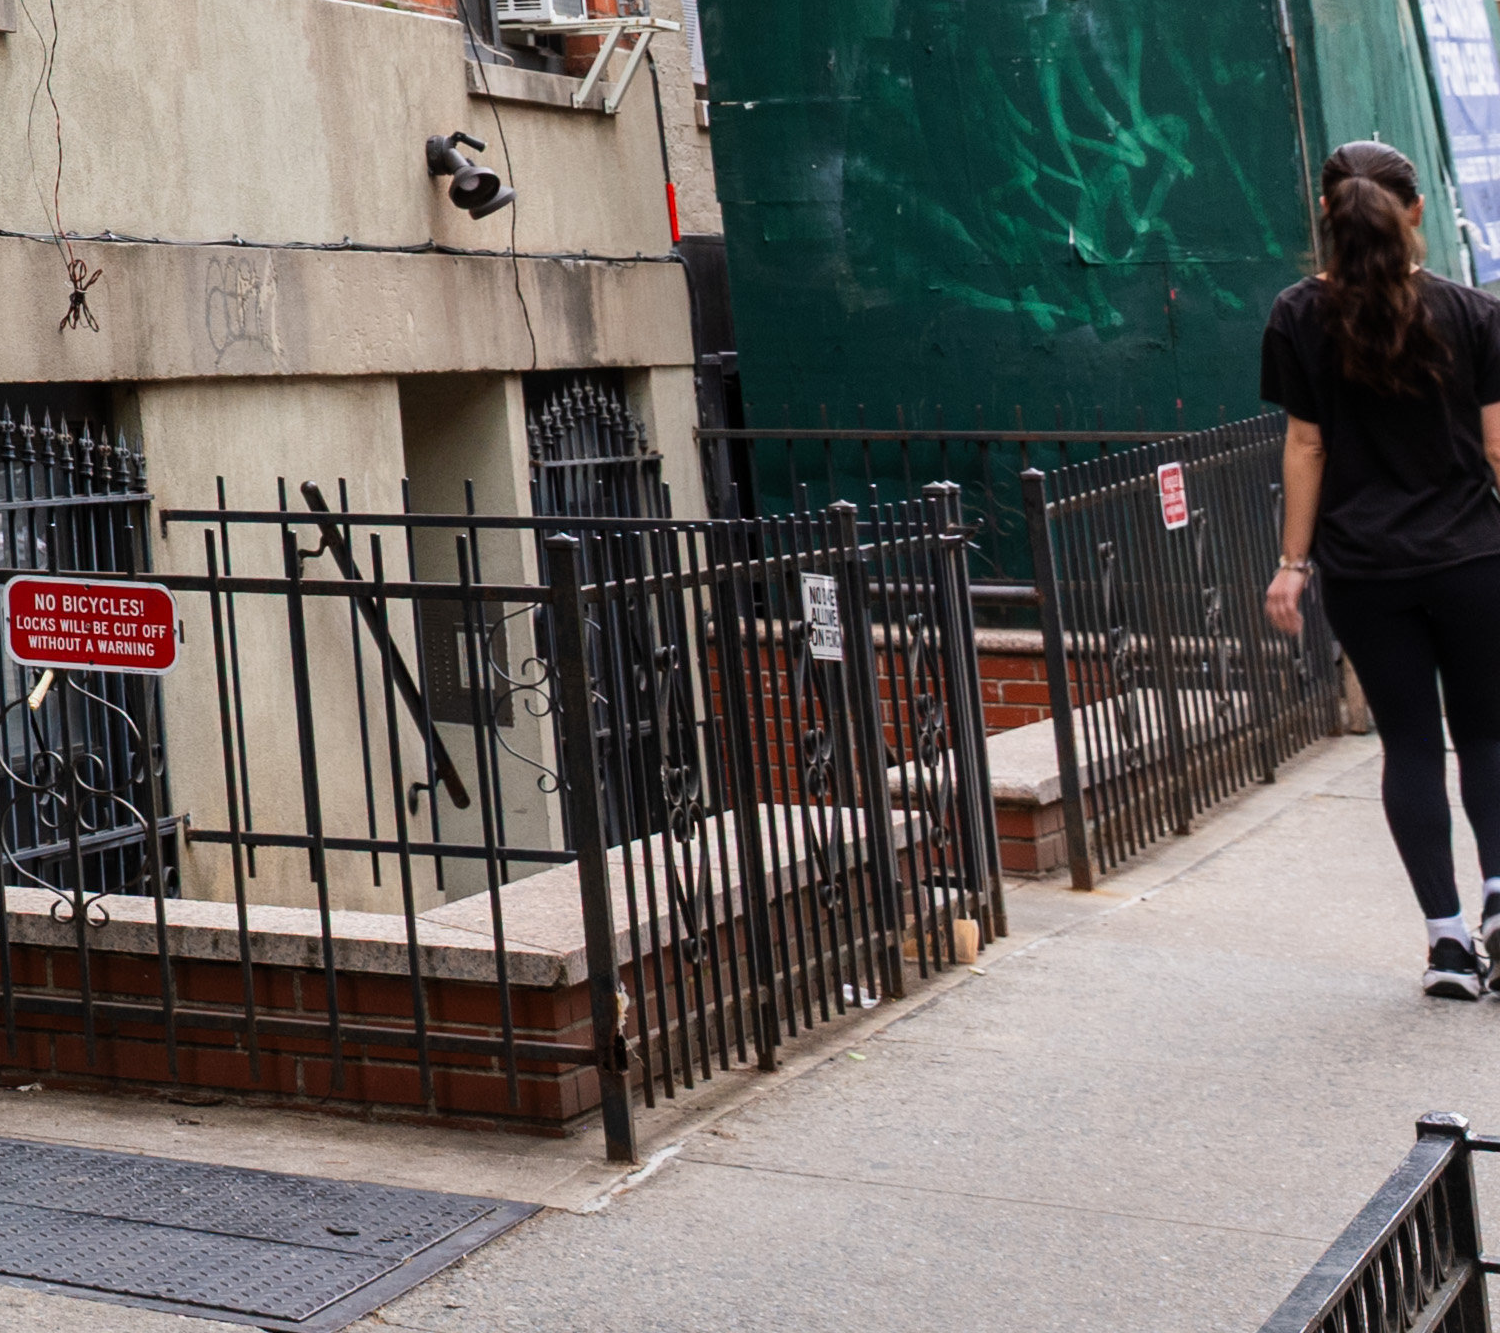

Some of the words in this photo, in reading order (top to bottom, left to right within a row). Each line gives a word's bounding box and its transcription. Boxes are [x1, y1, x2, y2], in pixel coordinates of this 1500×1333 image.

[34, 593, 56, 611] NO
[62, 595, 145, 617] BICYCLES!
[16, 615, 56, 632] LOCKS
[59, 619, 88, 634] WILL
[93, 621, 109, 636] BE
[113, 622, 138, 637] CUT
[142, 624, 167, 639] OFF
[28, 635, 81, 652] WITHOUT
[85, 639, 94, 653] A
[97, 640, 156, 657] WARNING
